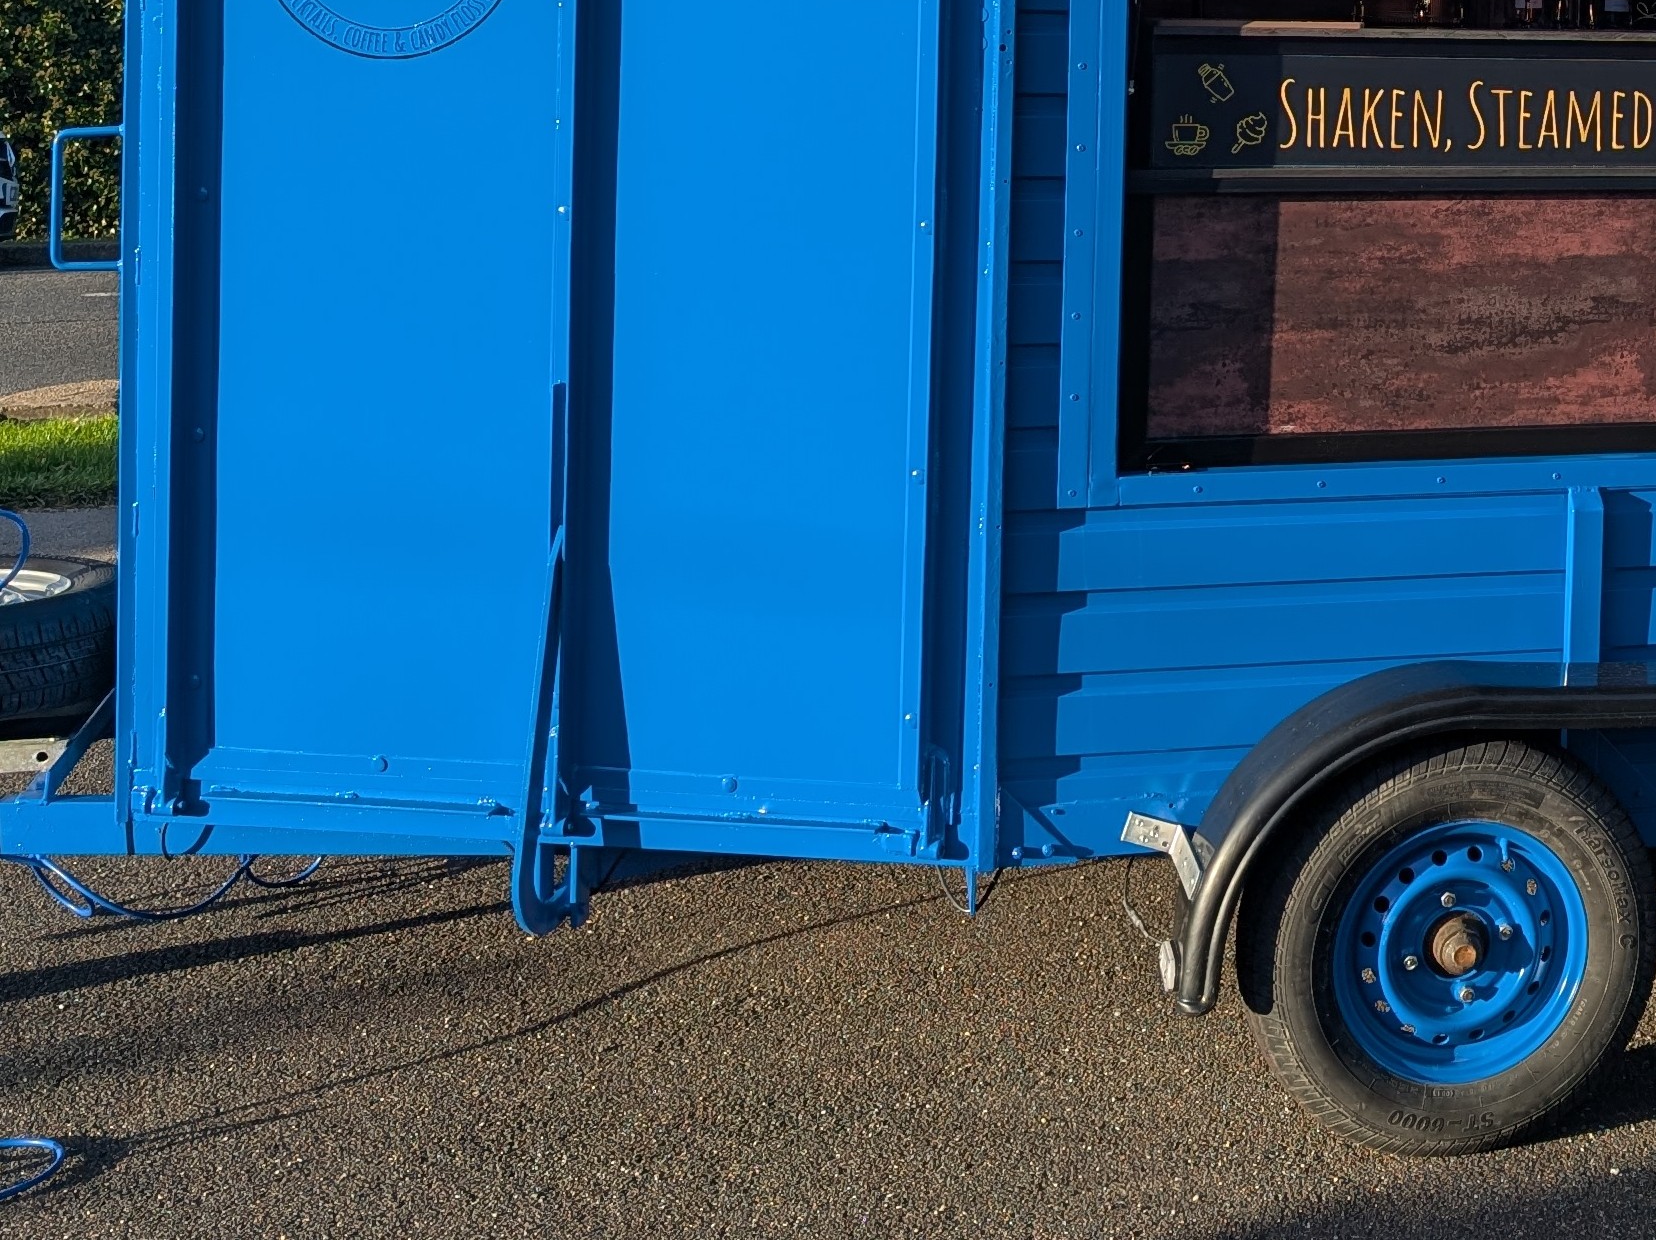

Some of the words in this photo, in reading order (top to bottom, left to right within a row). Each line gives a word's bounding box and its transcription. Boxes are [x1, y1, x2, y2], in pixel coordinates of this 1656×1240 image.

[343, 25, 387, 53] COFFEE
[394, 32, 406, 53] &
[410, 17, 453, 51] CANDY
[1280, 79, 1453, 153] SHAKEN,
[1468, 81, 1652, 150] STEAMED
[1387, 1110, 1495, 1133] ST-6000
